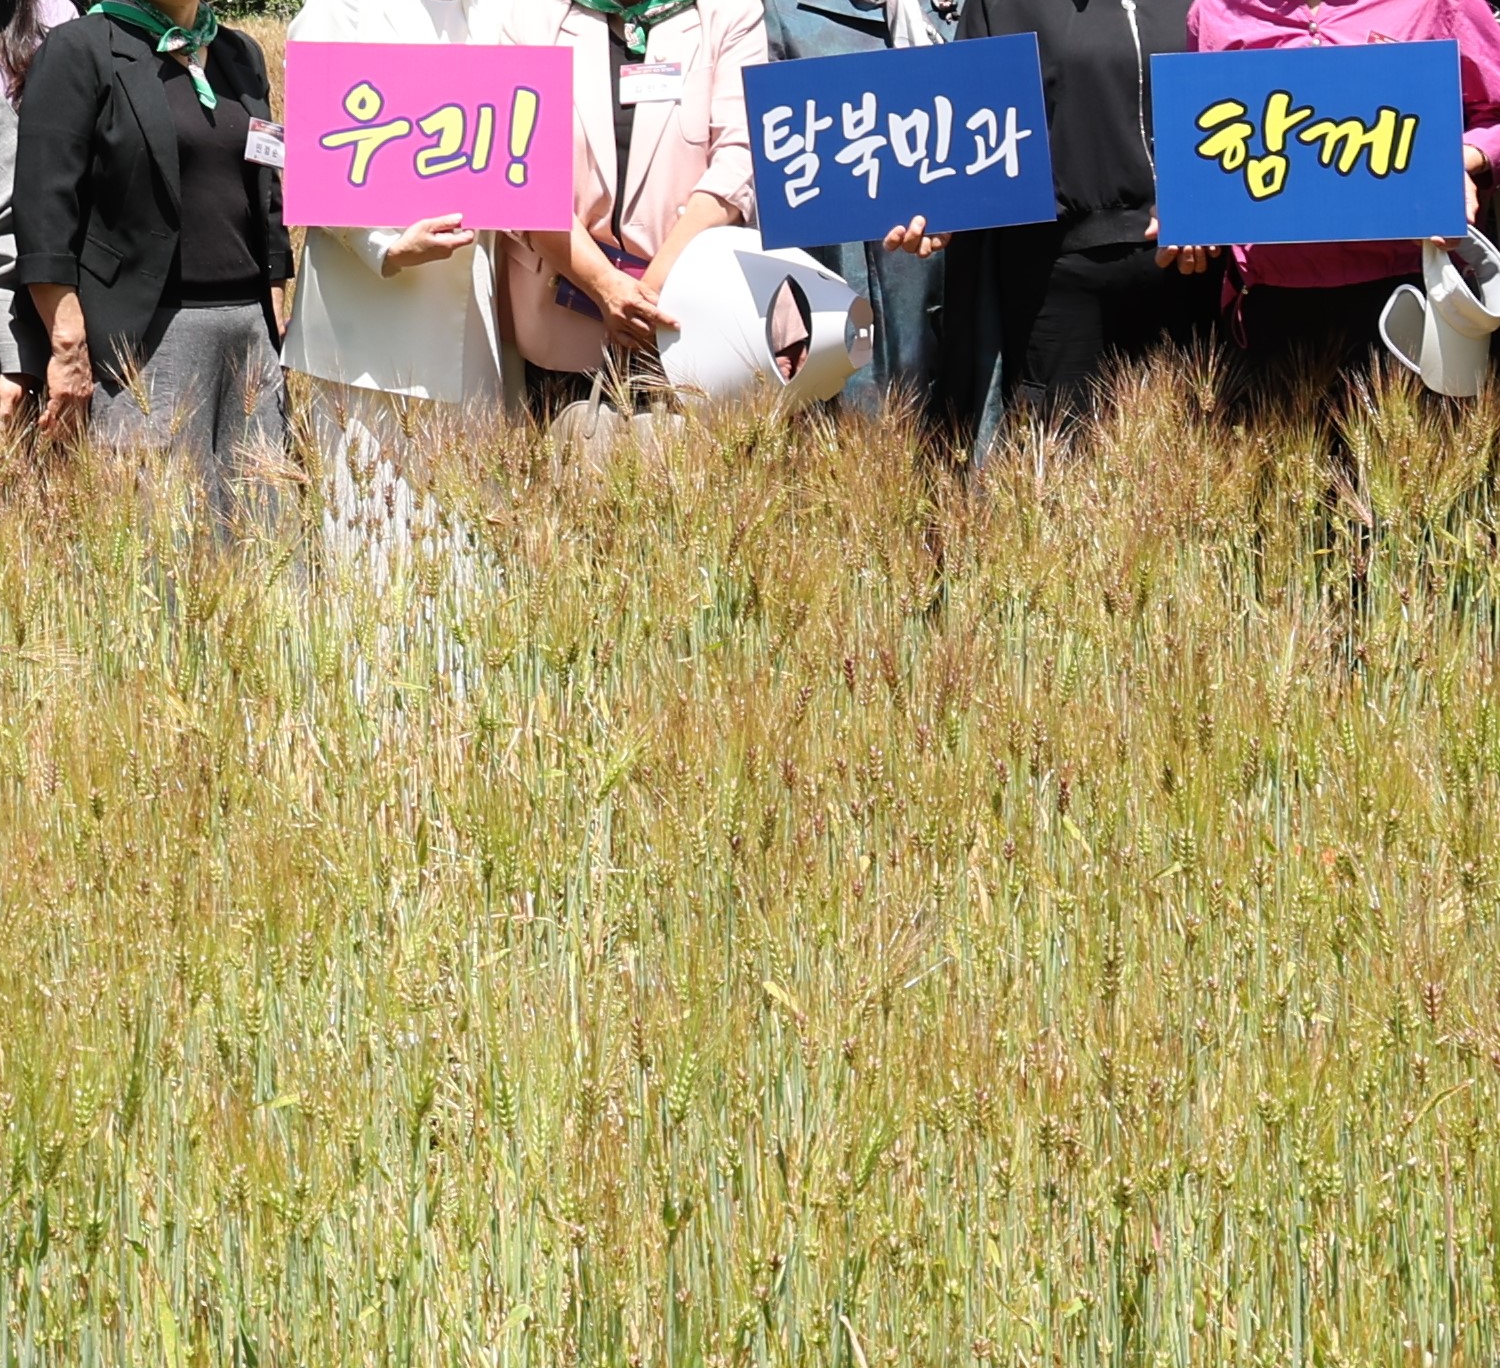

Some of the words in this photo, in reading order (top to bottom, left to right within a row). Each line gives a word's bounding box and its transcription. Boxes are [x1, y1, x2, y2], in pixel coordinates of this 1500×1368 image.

[319, 79, 541, 188] 우리!
[763, 92, 1032, 209] 탈북민과
[1195, 89, 1420, 201] 함께
